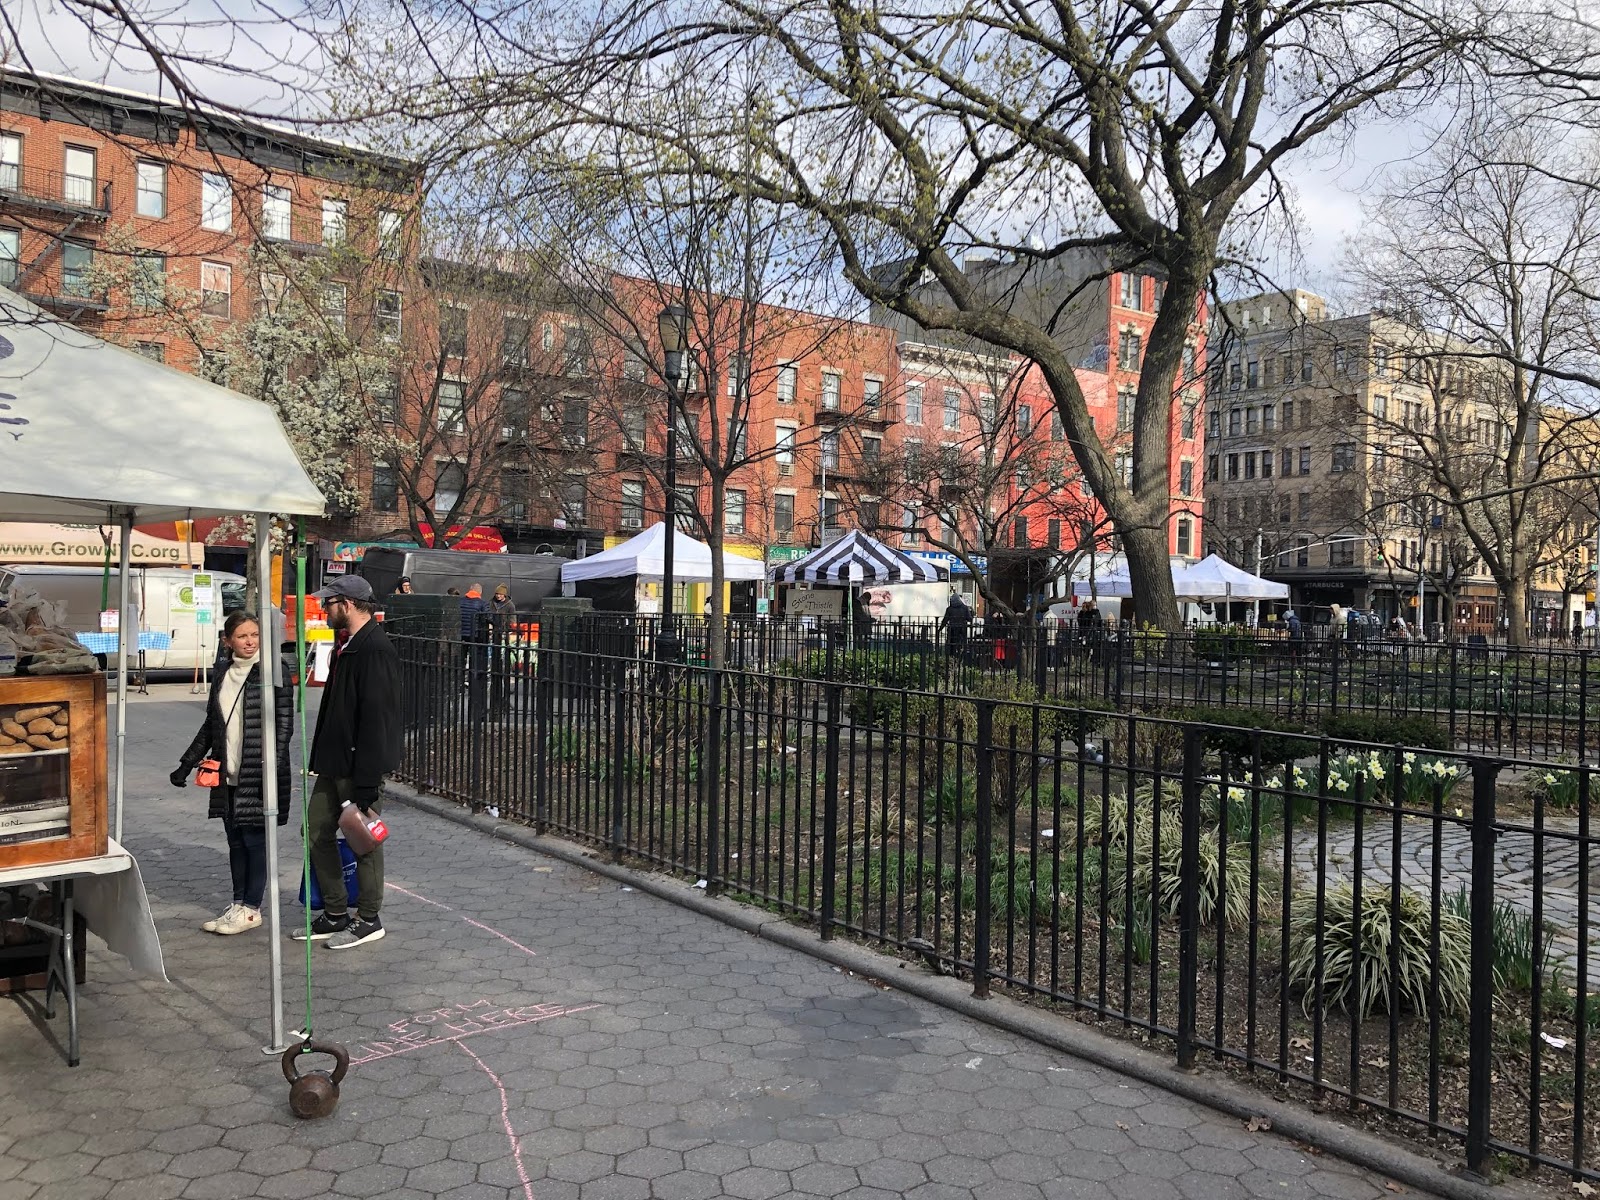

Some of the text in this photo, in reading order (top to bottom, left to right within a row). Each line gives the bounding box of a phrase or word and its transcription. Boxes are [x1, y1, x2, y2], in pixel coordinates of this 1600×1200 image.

[0, 541, 180, 561] www.GrowNC.org
[791, 593, 815, 609] Stone
[807, 601, 833, 610] Thistle
[445, 1002, 564, 1033] HERE
